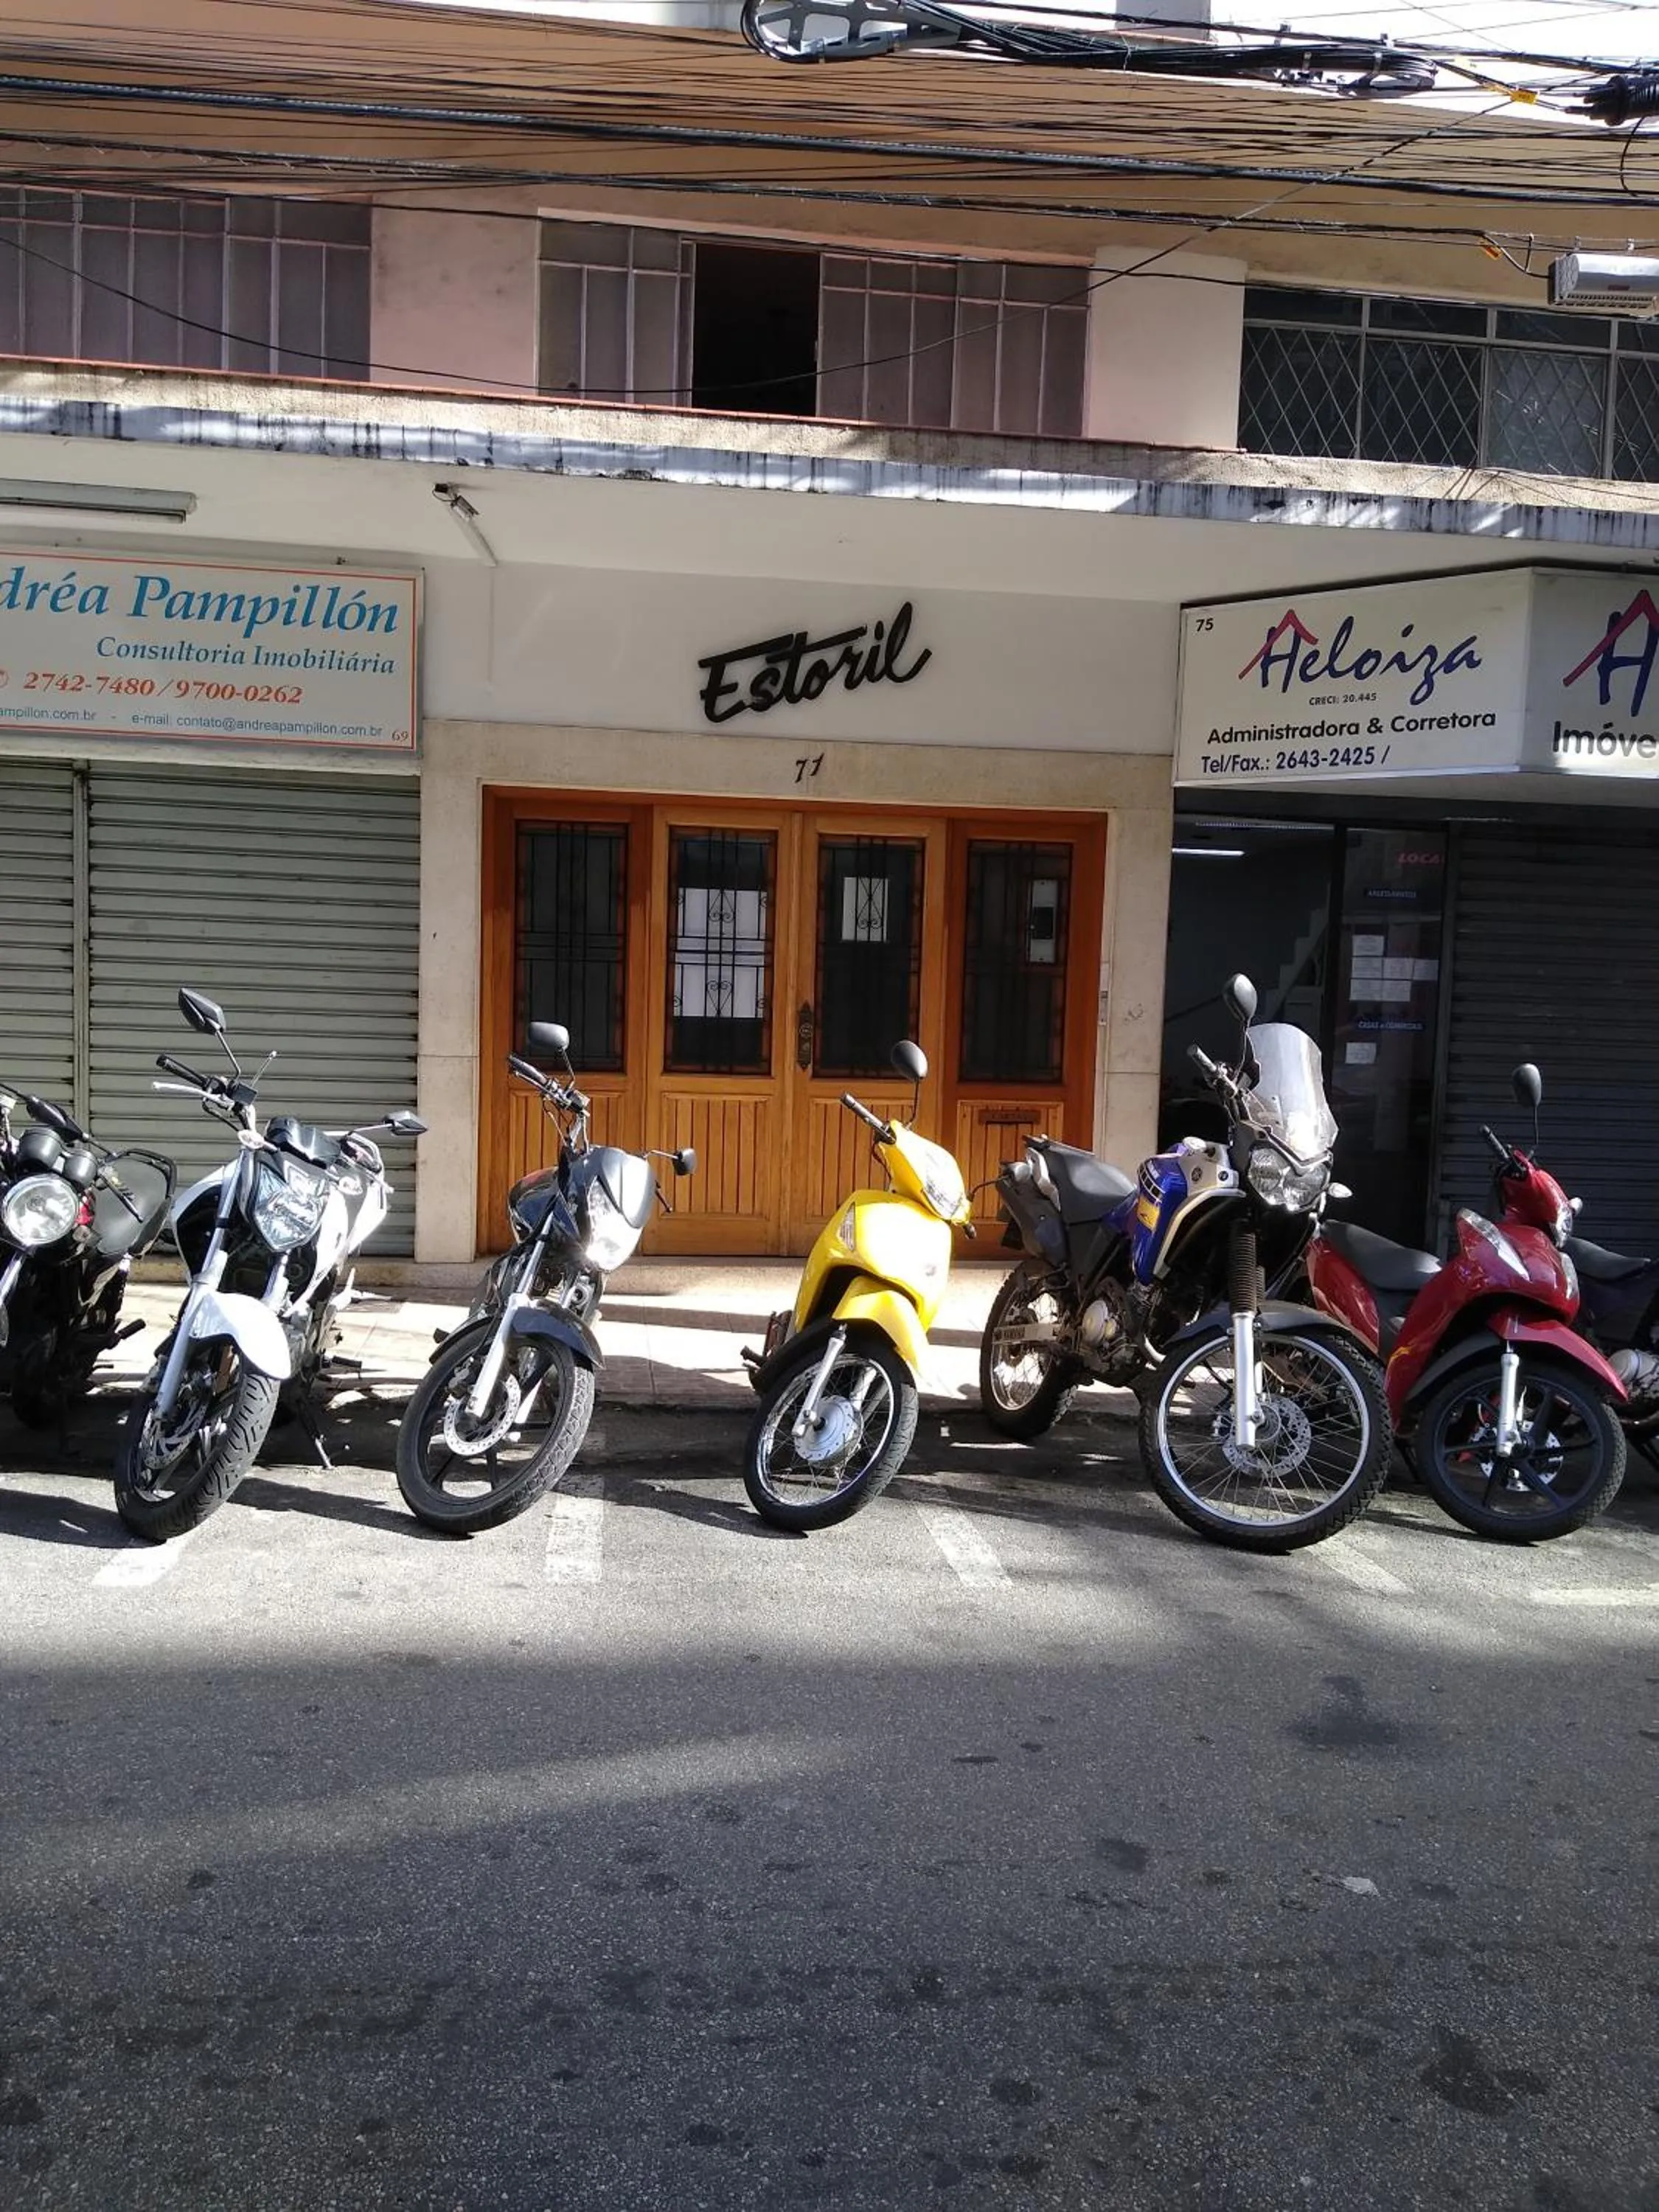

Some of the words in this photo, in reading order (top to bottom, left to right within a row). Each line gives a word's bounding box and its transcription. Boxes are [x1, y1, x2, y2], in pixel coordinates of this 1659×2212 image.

[0, 566, 110, 615] dréa
[126, 575, 398, 639] Pampillón
[1196, 618, 1214, 632] 75
[97, 636, 245, 665] Consultoria
[252, 645, 394, 674] Imobiliária
[698, 602, 932, 723] Estoril
[1239, 609, 1482, 706] Heloiza
[1343, 692, 1377, 703] 20.445
[392, 730, 409, 742] 69
[1207, 720, 1360, 744] Administradora
[1367, 717, 1383, 734] &
[1391, 712, 1496, 732] Corretora
[1553, 720, 1657, 758] Imóve
[794, 753, 825, 783] 71
[1201, 754, 1270, 773] Tel/Fax.:
[1276, 746, 1375, 770] 2643-2425
